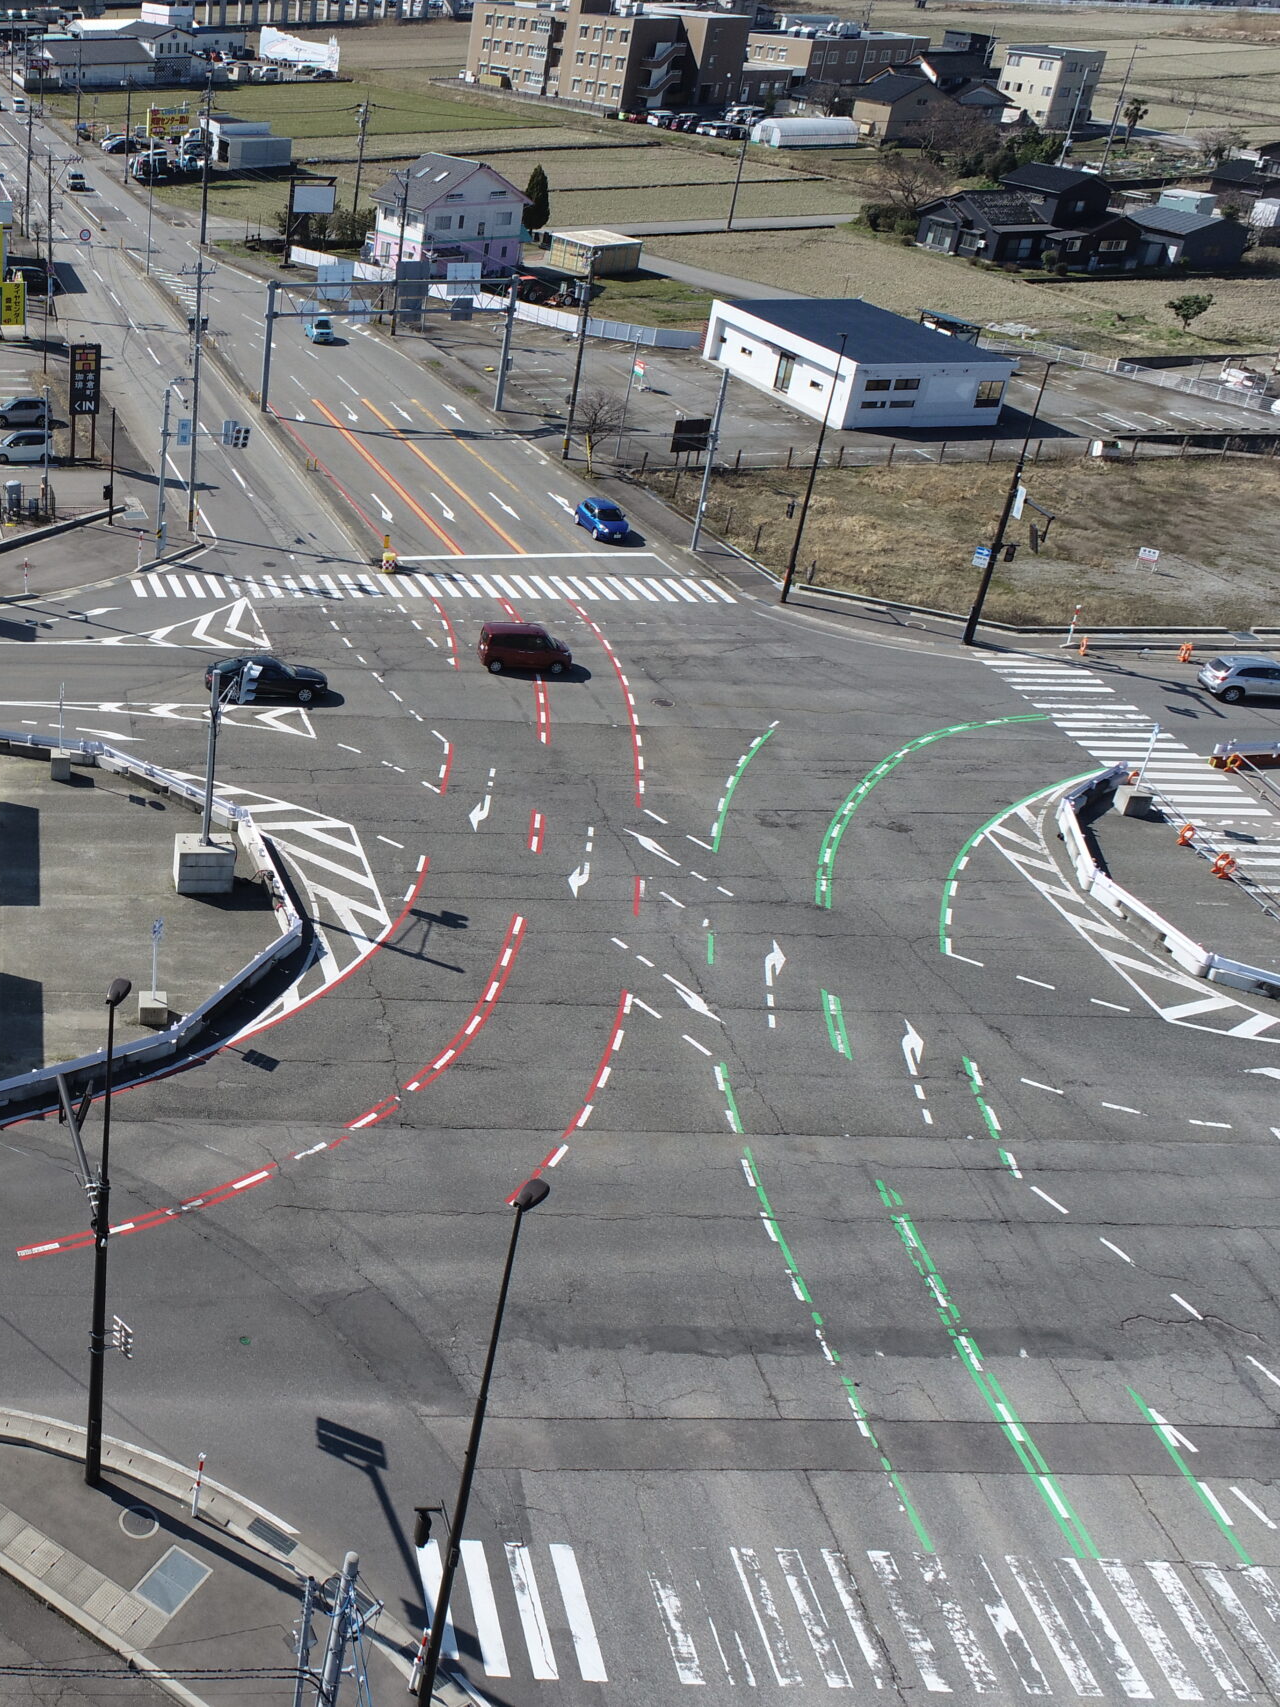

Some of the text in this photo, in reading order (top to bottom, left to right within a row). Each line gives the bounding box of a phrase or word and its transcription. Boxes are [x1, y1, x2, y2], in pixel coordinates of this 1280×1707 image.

[74, 373, 84, 389] 珈琲
[85, 372, 95, 397] 高倉町
[82, 400, 95, 411] IN
